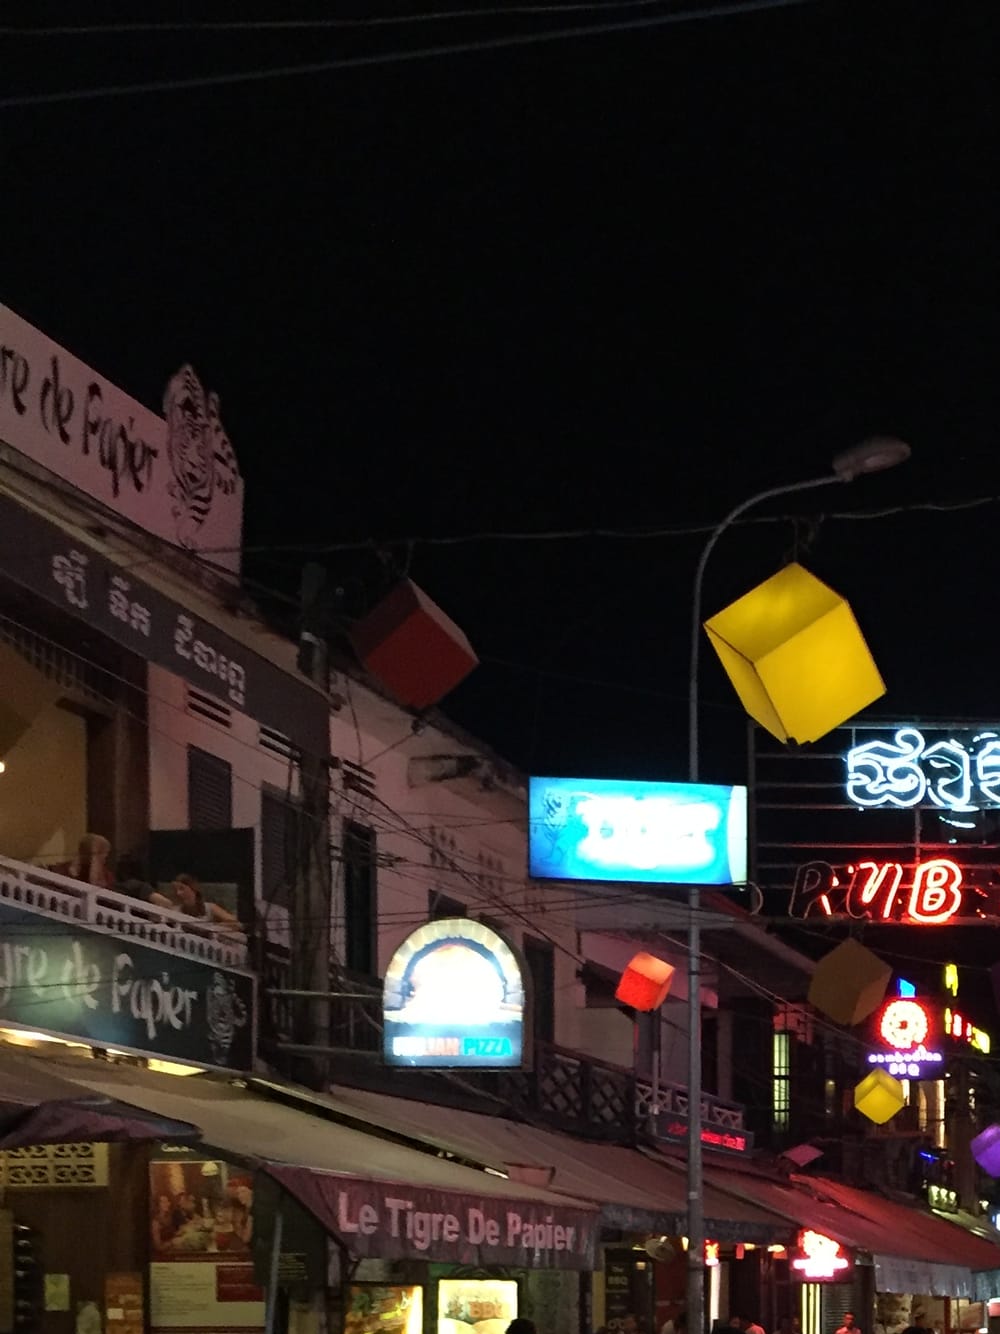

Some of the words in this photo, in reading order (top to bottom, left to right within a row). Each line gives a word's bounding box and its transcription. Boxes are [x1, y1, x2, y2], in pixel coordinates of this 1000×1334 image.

[112, 952, 198, 1041] Papier
[462, 1036, 513, 1057] PIZZA
[338, 1191, 379, 1236] Le
[384, 1197, 460, 1251] Tigre
[468, 1207, 501, 1246] De
[506, 1211, 575, 1257] Papier
